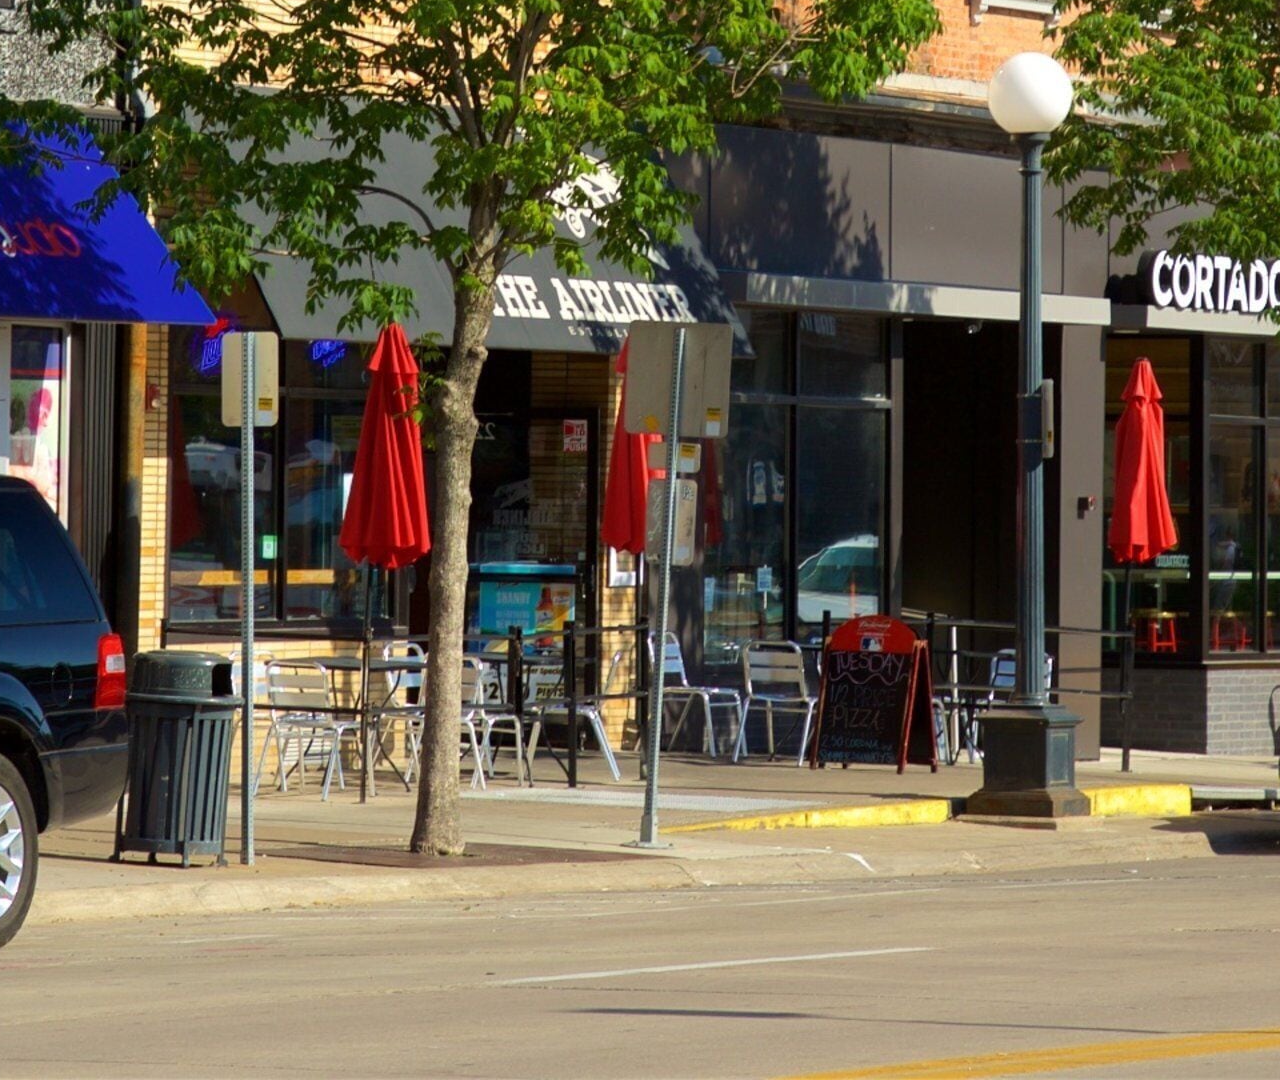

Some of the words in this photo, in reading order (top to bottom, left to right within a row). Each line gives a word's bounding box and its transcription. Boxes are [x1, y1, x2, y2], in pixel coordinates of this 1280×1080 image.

[550, 277, 699, 324] AIRLINER
[831, 652, 904, 680] TUESDAY
[832, 705, 880, 731] PIZZA
